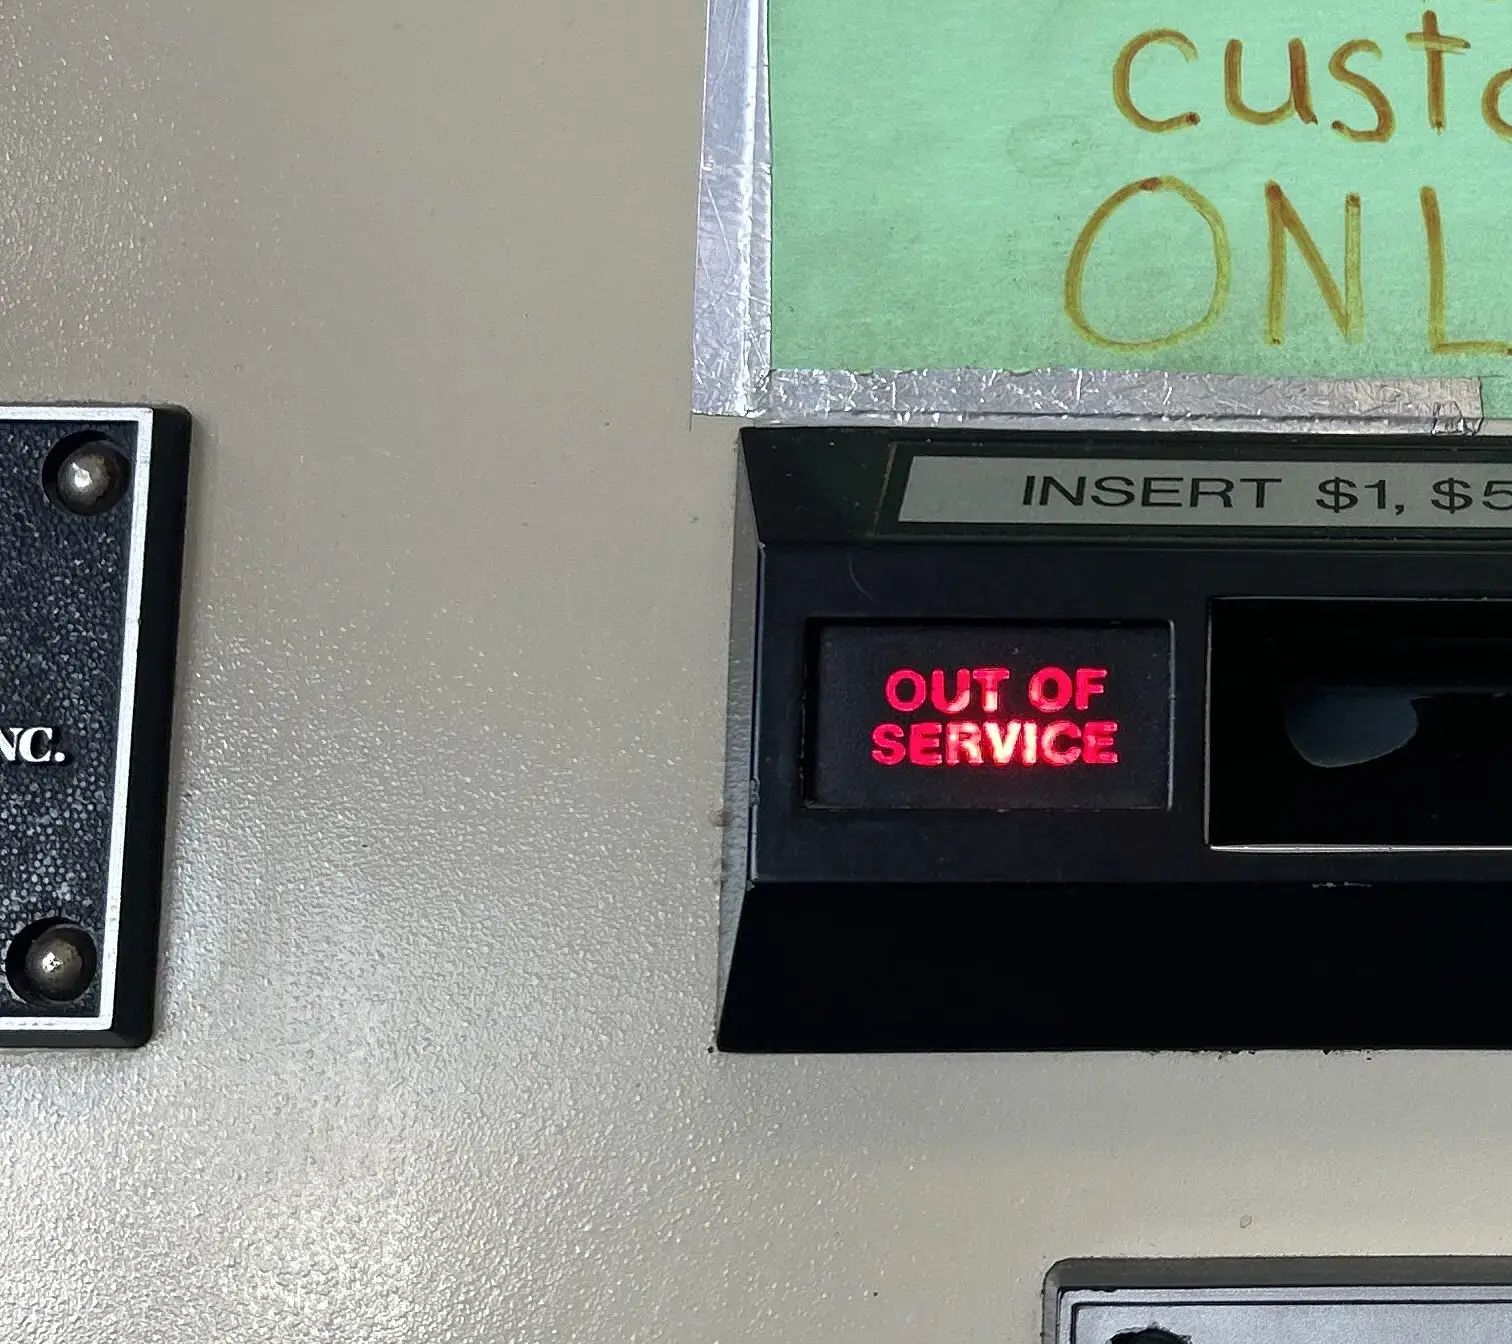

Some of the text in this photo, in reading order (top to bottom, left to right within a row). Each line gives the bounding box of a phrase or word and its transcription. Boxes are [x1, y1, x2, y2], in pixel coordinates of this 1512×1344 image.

[1022, 475, 1283, 509] INSERT
[1315, 476, 1405, 517] $1,
[885, 666, 1108, 714] OUT OF
[871, 720, 1119, 767] SERVICE
